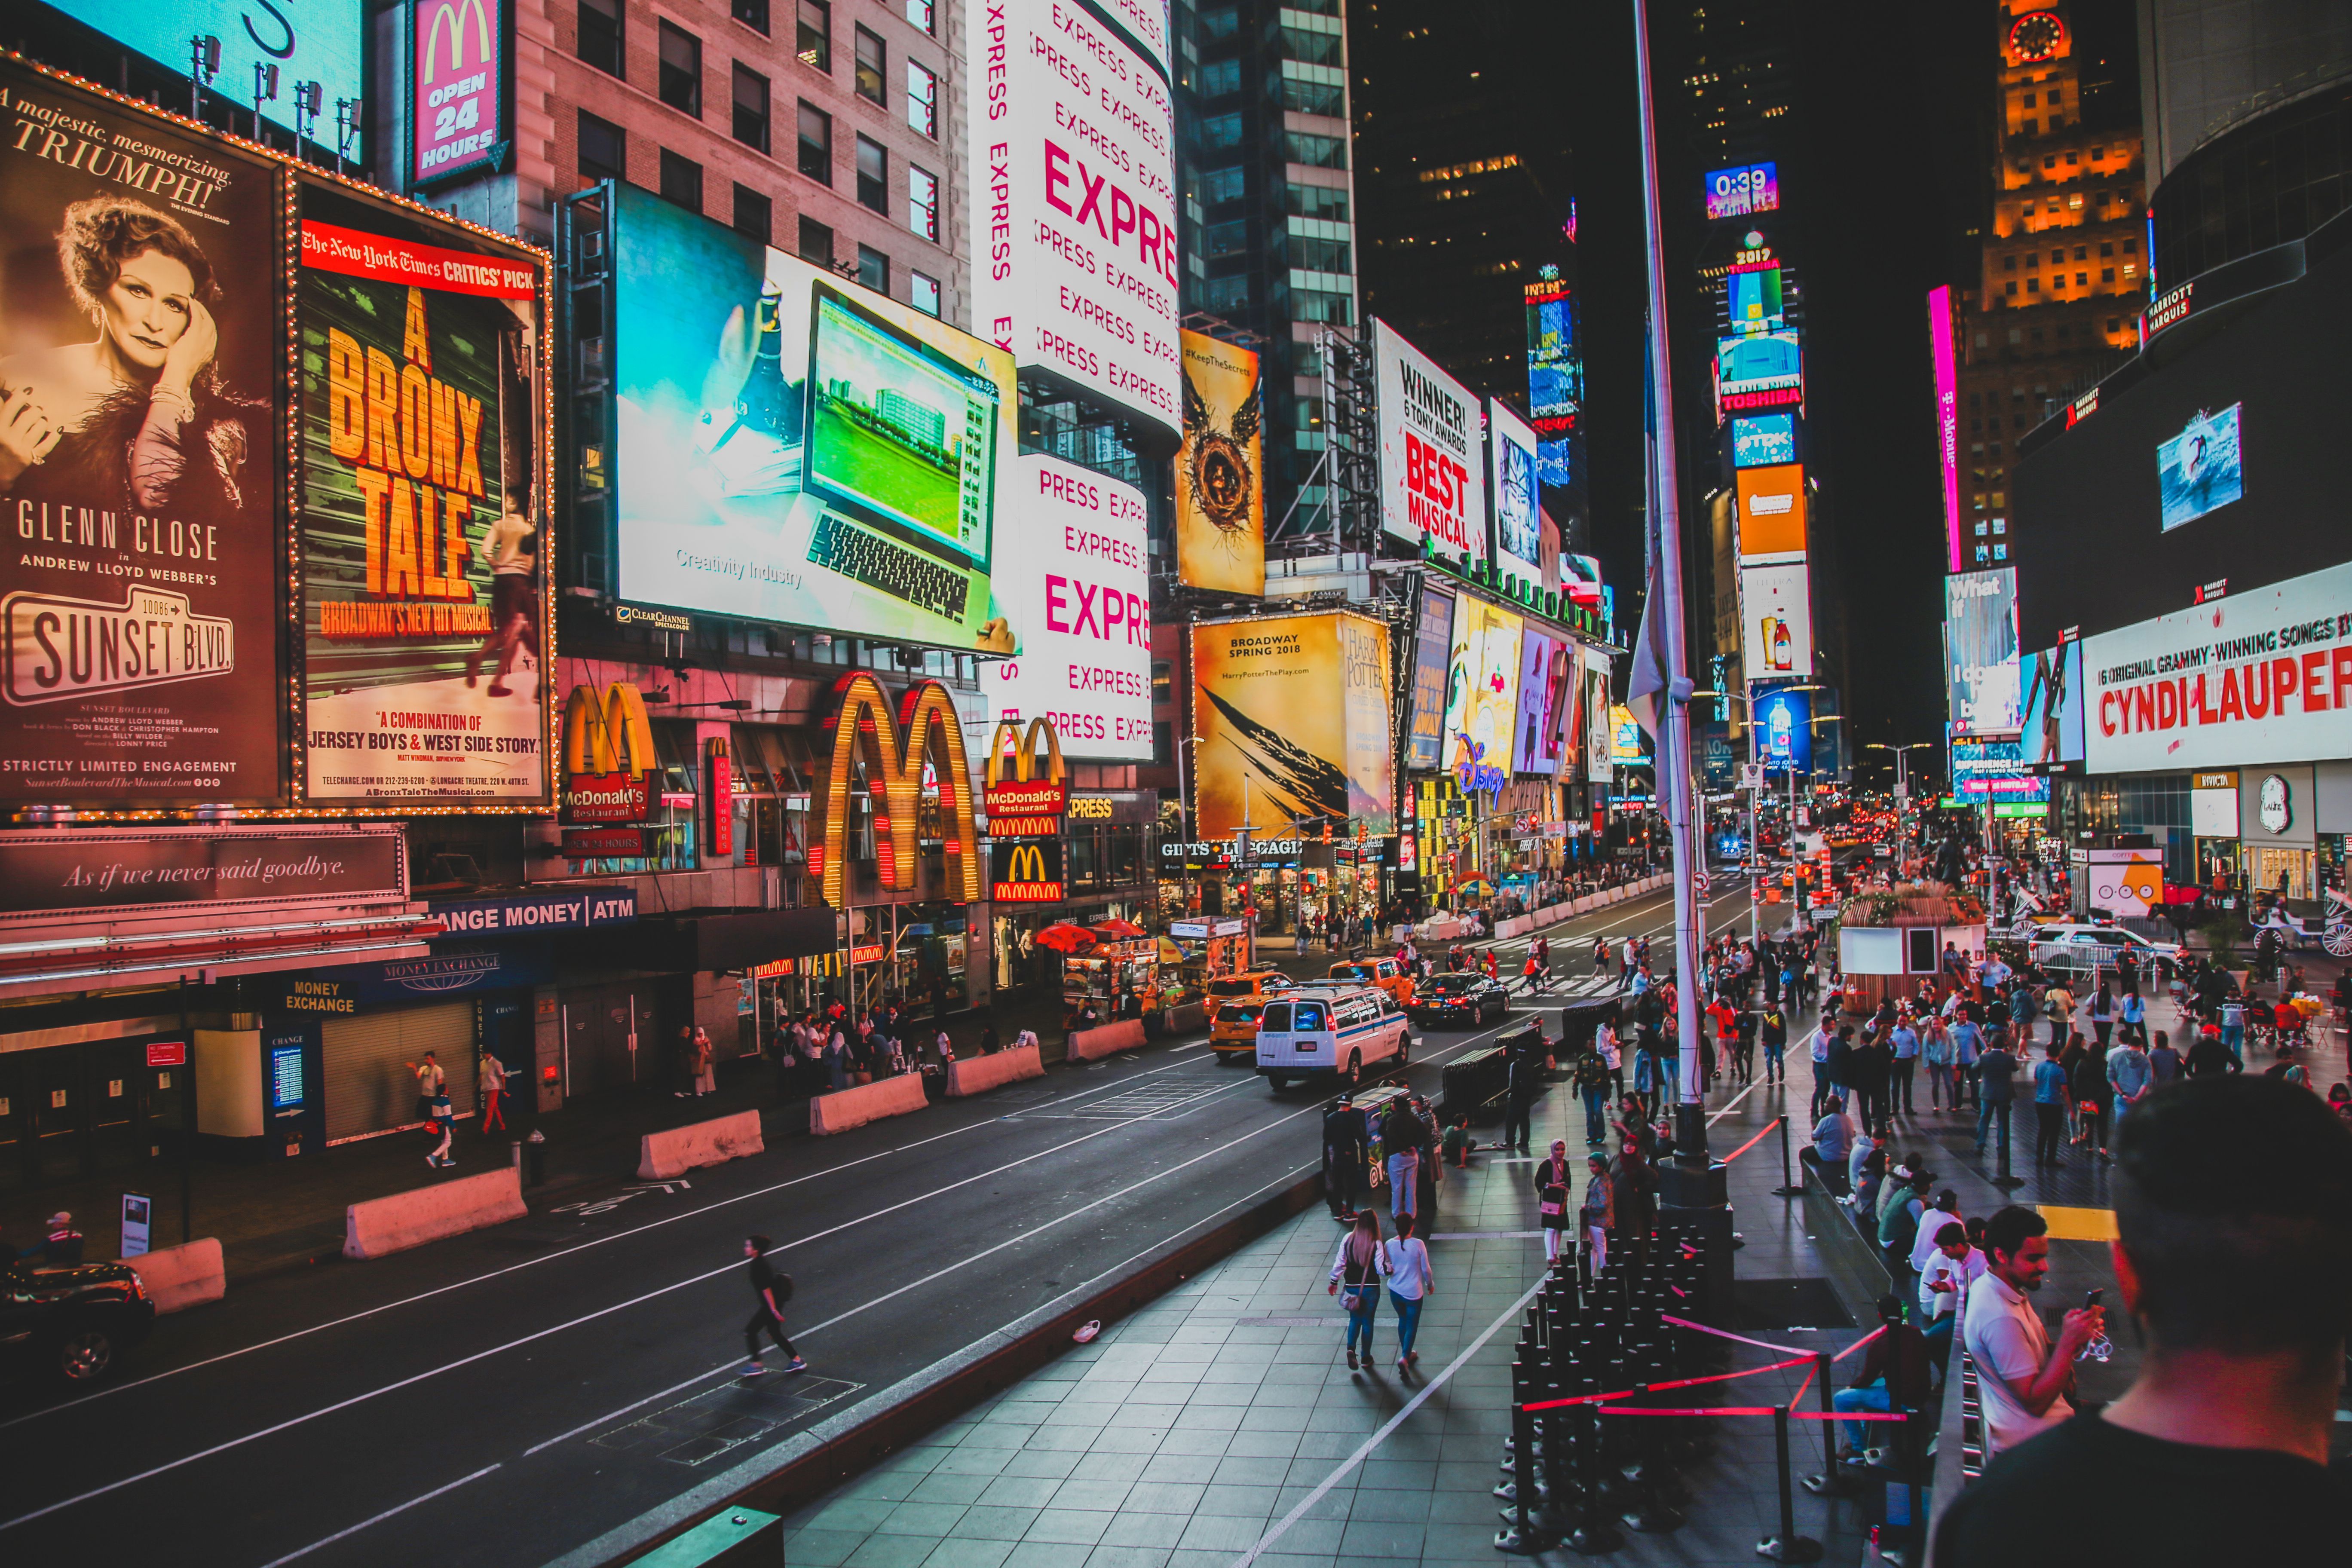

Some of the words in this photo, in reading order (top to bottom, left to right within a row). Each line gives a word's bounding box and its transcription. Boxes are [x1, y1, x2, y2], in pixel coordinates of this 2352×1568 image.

[1053, 3, 1127, 82] EXPRESS
[429, 72, 486, 108] OPEN
[435, 97, 479, 141] 24
[1101, 87, 1165, 156] EXPRESS
[15, 100, 107, 143] majestic,
[113, 135, 232, 188] mesmerizing,
[421, 129, 493, 169] HOURS
[1055, 101, 1130, 172] EXPRESS
[1715, 169, 1766, 196] 0:39
[171, 202, 180, 211] THE
[181, 205, 203, 217] EVENING
[204, 213, 230, 225] STANDARD
[990, 142, 1011, 281] EXPRESS
[302, 230, 328, 253] The
[331, 237, 361, 260] New
[363, 245, 398, 270] York
[400, 251, 441, 277] Times
[443, 260, 501, 287] CRITICS’
[503, 270, 535, 290] PICK
[1728, 258, 1781, 275] TOSHIBA
[1736, 248, 1771, 265] 2017
[1106, 262, 1170, 320] EXPRESS
[2149, 282, 2194, 319] MARRIOTT
[1060, 285, 1134, 344] EXPRESS
[2149, 300, 2187, 334] MARQUIS
[403, 285, 432, 372] A
[1185, 347, 1250, 377] #KeepTheSecrets
[1109, 362, 1173, 413] EXPRESS
[1400, 358, 1467, 438] WINNER!
[1722, 388, 1801, 410] TOSHIBA
[2076, 387, 2099, 410] MARRIOTT
[330, 326, 485, 501] BRONX
[2076, 400, 2098, 421] MARQUIS
[1404, 400, 1410, 417] 6
[1411, 405, 1433, 434] TONY
[1435, 420, 1467, 456] AWARDS
[1750, 431, 1789, 448] TDK
[1406, 431, 1469, 518] BEST
[1040, 469, 1099, 511] PRESS
[18, 499, 116, 549] GLENN
[135, 516, 217, 560] CLOSE
[356, 466, 475, 603] TALE
[1407, 491, 1470, 551] MUSICAL
[119, 553, 129, 561] in
[1065, 525, 1138, 570] EXPRESS
[21, 554, 90, 572] ANDREW
[97, 563, 144, 578] LLOYD
[150, 568, 217, 585] WEBBER’S
[676, 548, 744, 580] Creativity
[748, 561, 803, 590] Industry
[1462, 552, 1517, 599] 1540
[1950, 576, 2000, 600] What
[2204, 579, 2227, 591] MARRIOTT
[2204, 588, 2225, 600] MARQUIS
[143, 599, 168, 616] 10086
[320, 601, 405, 635] BROADWAY’S
[407, 604, 430, 634] NEW
[433, 605, 451, 633] HIT
[452, 605, 493, 632] MUSICAL
[1951, 599, 1964, 618] if
[655, 621, 689, 631] SPECTACOLOR
[34, 611, 173, 689] SUNSET
[184, 623, 230, 671] BLVD.
[1229, 647, 1272, 658] SPRING
[1277, 645, 1301, 654] 2018
[1231, 634, 1298, 648] BROADWAY
[1348, 628, 1384, 665] HARRY
[2108, 659, 2156, 684] ORIGINAL
[2279, 617, 2335, 649] SONGS
[1069, 664, 1141, 698] EXPRESS
[1222, 668, 1309, 680] HarryPotterThePlay.com
[1347, 656, 1387, 691] POTTER
[1419, 665, 1446, 691] COME
[80, 705, 116, 713] SUNSET
[118, 706, 170, 715] BOULEVARD
[2099, 676, 2189, 738] CYNDI
[390, 711, 467, 731] COMBINATION
[469, 716, 481, 731] OF
[1046, 710, 1105, 740] PRESS
[1413, 711, 1442, 736] AWAY
[308, 731, 365, 749] JERSEY
[369, 732, 408, 750] BOYS
[410, 734, 421, 750] &
[423, 734, 462, 751] WEST
[465, 735, 493, 753] SIDE
[3, 760, 73, 771] STRICTLY
[80, 761, 137, 772] LIMITED
[144, 761, 237, 772] ENGAGEMENT
[1955, 759, 2012, 769] EXPERIENCE
[24, 777, 192, 788] SunsetBoulevardTheMusical.com
[322, 776, 375, 785] TELECHARGE.COM
[376, 777, 384, 785] OR
[385, 777, 425, 785] 212-239-6200
[437, 777, 464, 785] LONGACRE
[465, 777, 489, 786] THEATRE,
[490, 778, 499, 786] 220
[508, 778, 520, 786] 48TH
[366, 788, 495, 796] ABronxTaleTheMusical.com
[2201, 775, 2229, 787] INVICTA
[560, 788, 643, 806] McDonald’s
[987, 790, 1060, 805] McDonald’s
[999, 803, 1048, 812] Restaurant
[573, 807, 629, 818] Restaurant
[564, 839, 588, 850] OPEN
[591, 839, 603, 849] 24
[605, 838, 638, 848] HOURS
[62, 864, 93, 887] As
[99, 862, 122, 892] if
[123, 867, 153, 884] we
[157, 865, 214, 883] never
[217, 858, 259, 879] said
[262, 855, 345, 884] goodbye.
[506, 903, 581, 926] MONEY
[594, 899, 633, 919] ATM
[1089, 913, 1111, 922] EXPRESS
[384, 961, 429, 978] MONEY
[433, 955, 500, 973] EXCHANGE
[295, 981, 339, 996] MONEY
[286, 996, 354, 1013] EXCHANGE
[272, 1035, 303, 1046] CHANGE
